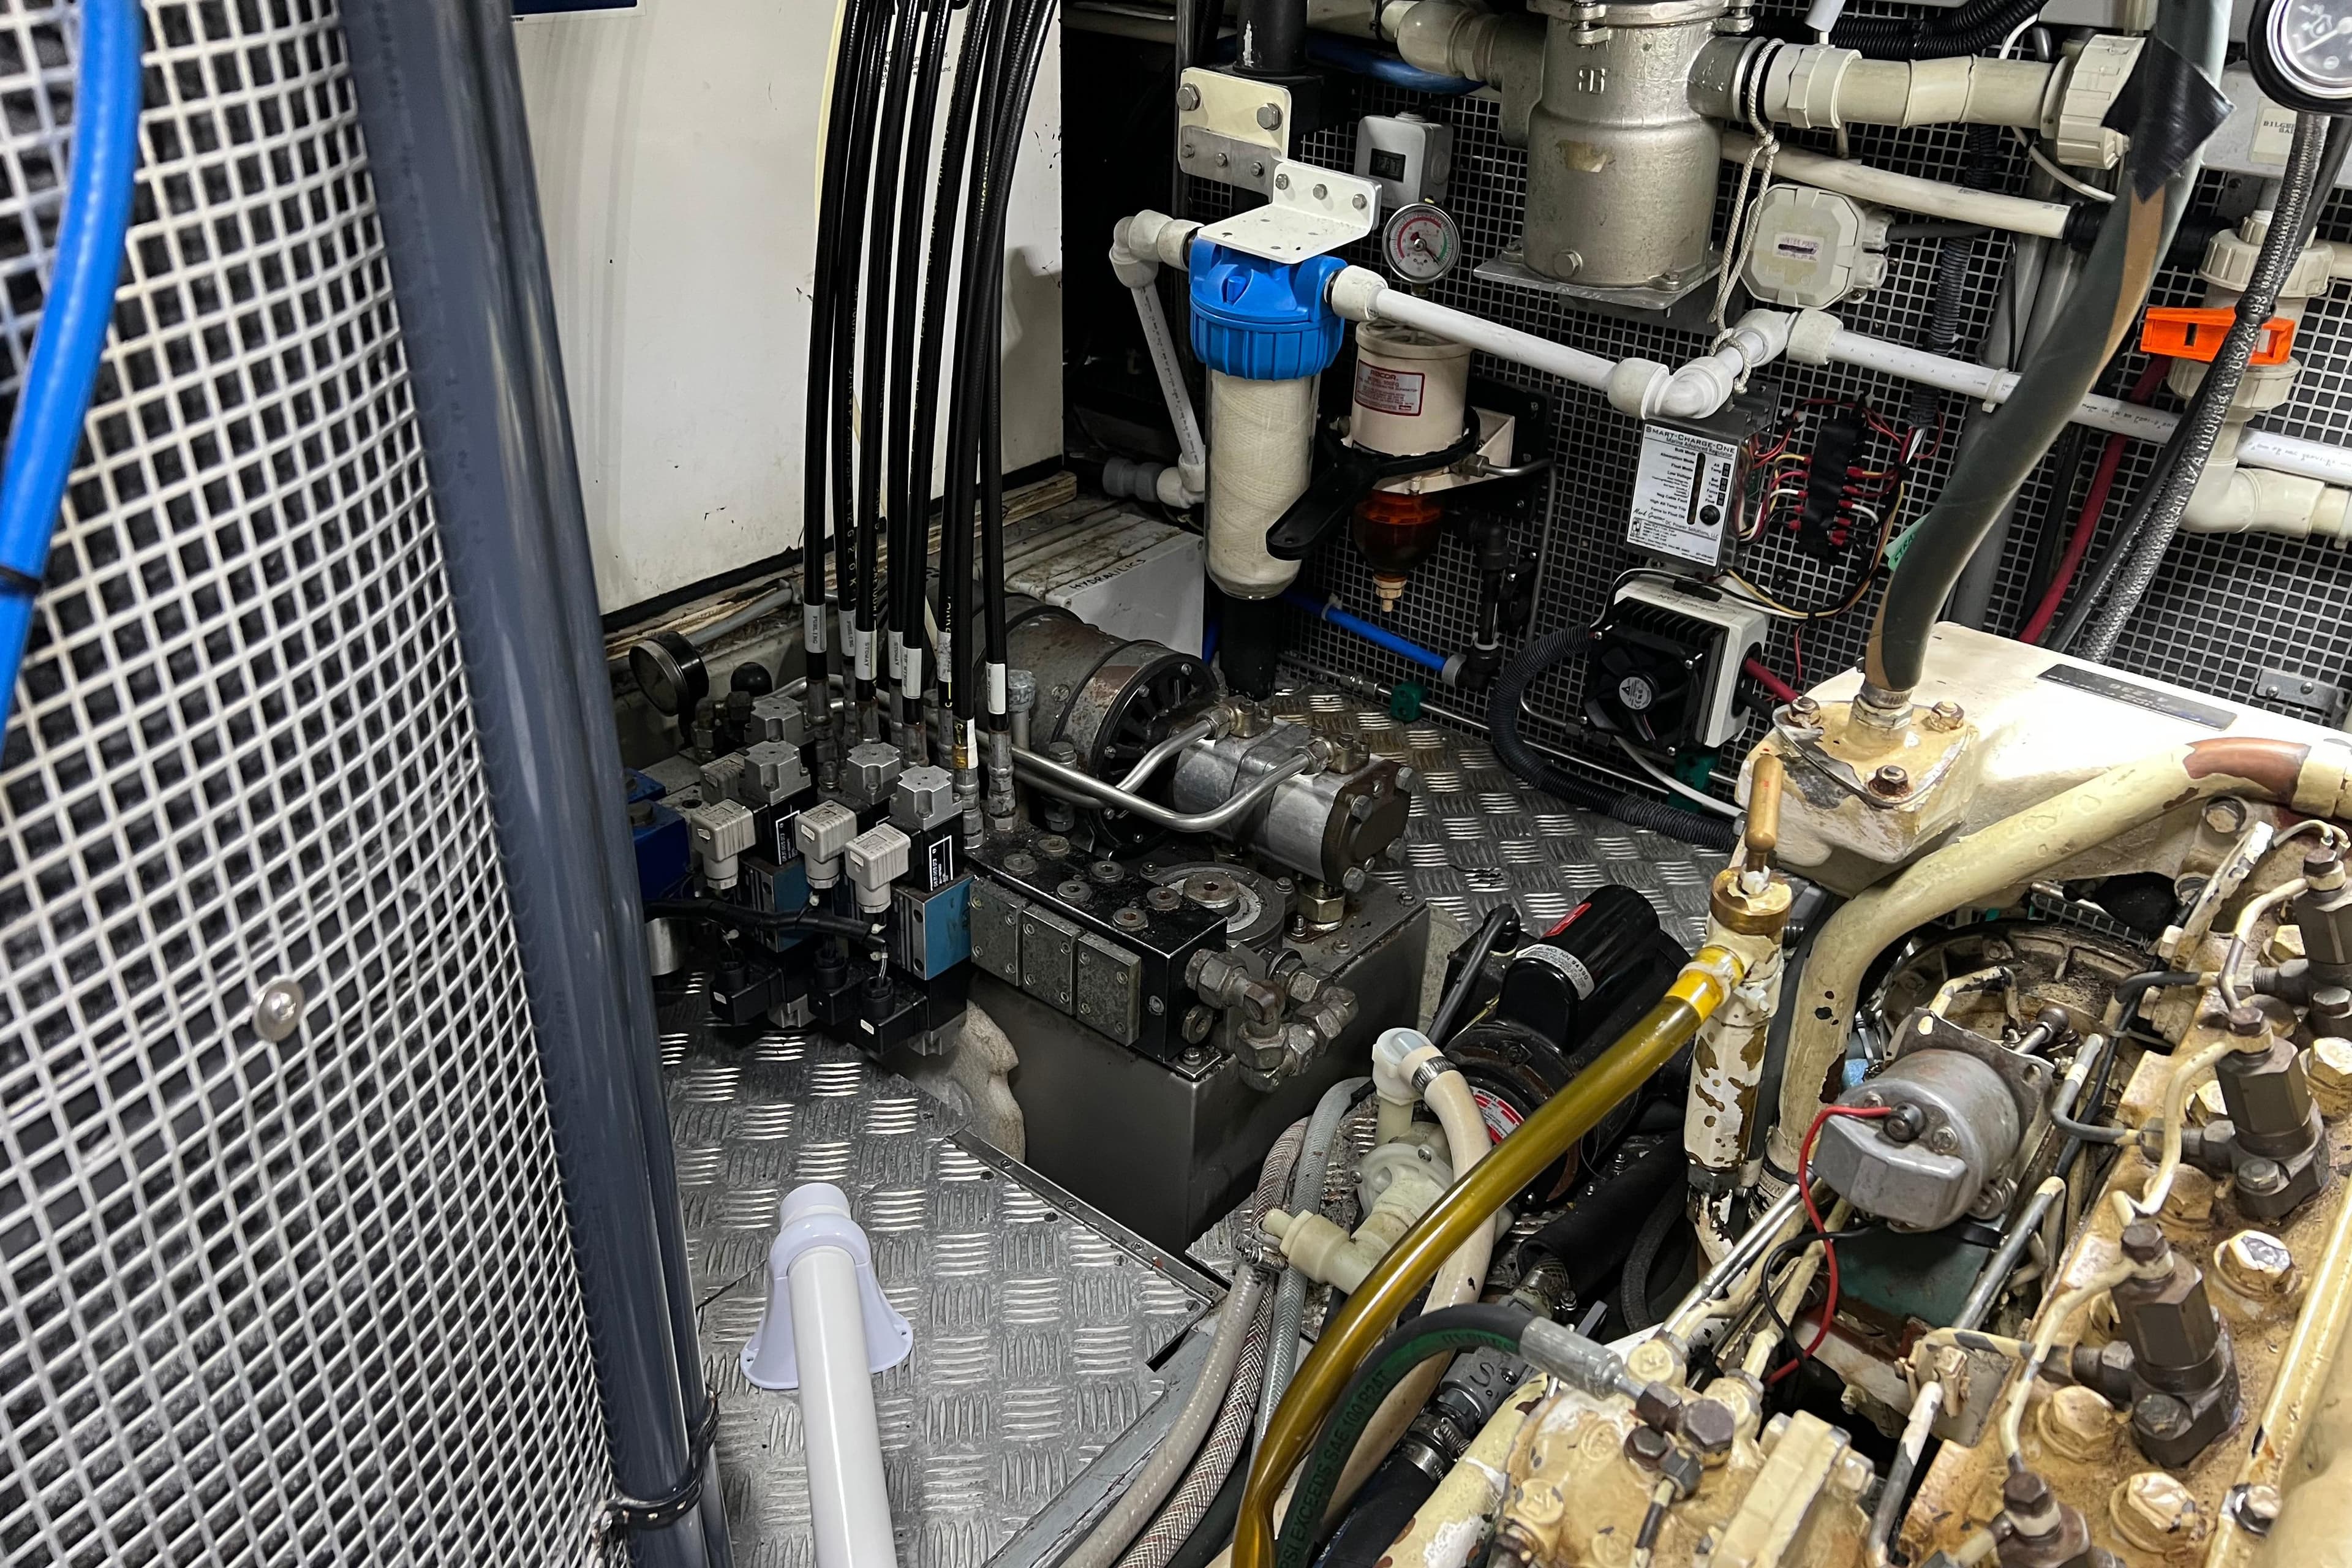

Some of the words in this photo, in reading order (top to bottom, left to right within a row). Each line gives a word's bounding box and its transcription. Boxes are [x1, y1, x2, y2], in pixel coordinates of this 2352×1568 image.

[1645, 426, 1735, 453] SMART-CHARGE-ONE
[1069, 559, 1147, 590] HYDRAULICS
[1289, 1464, 1331, 1540] EXCEEDS
[1324, 1428, 1349, 1460] SAE
[1343, 1406, 1365, 1425] 100
